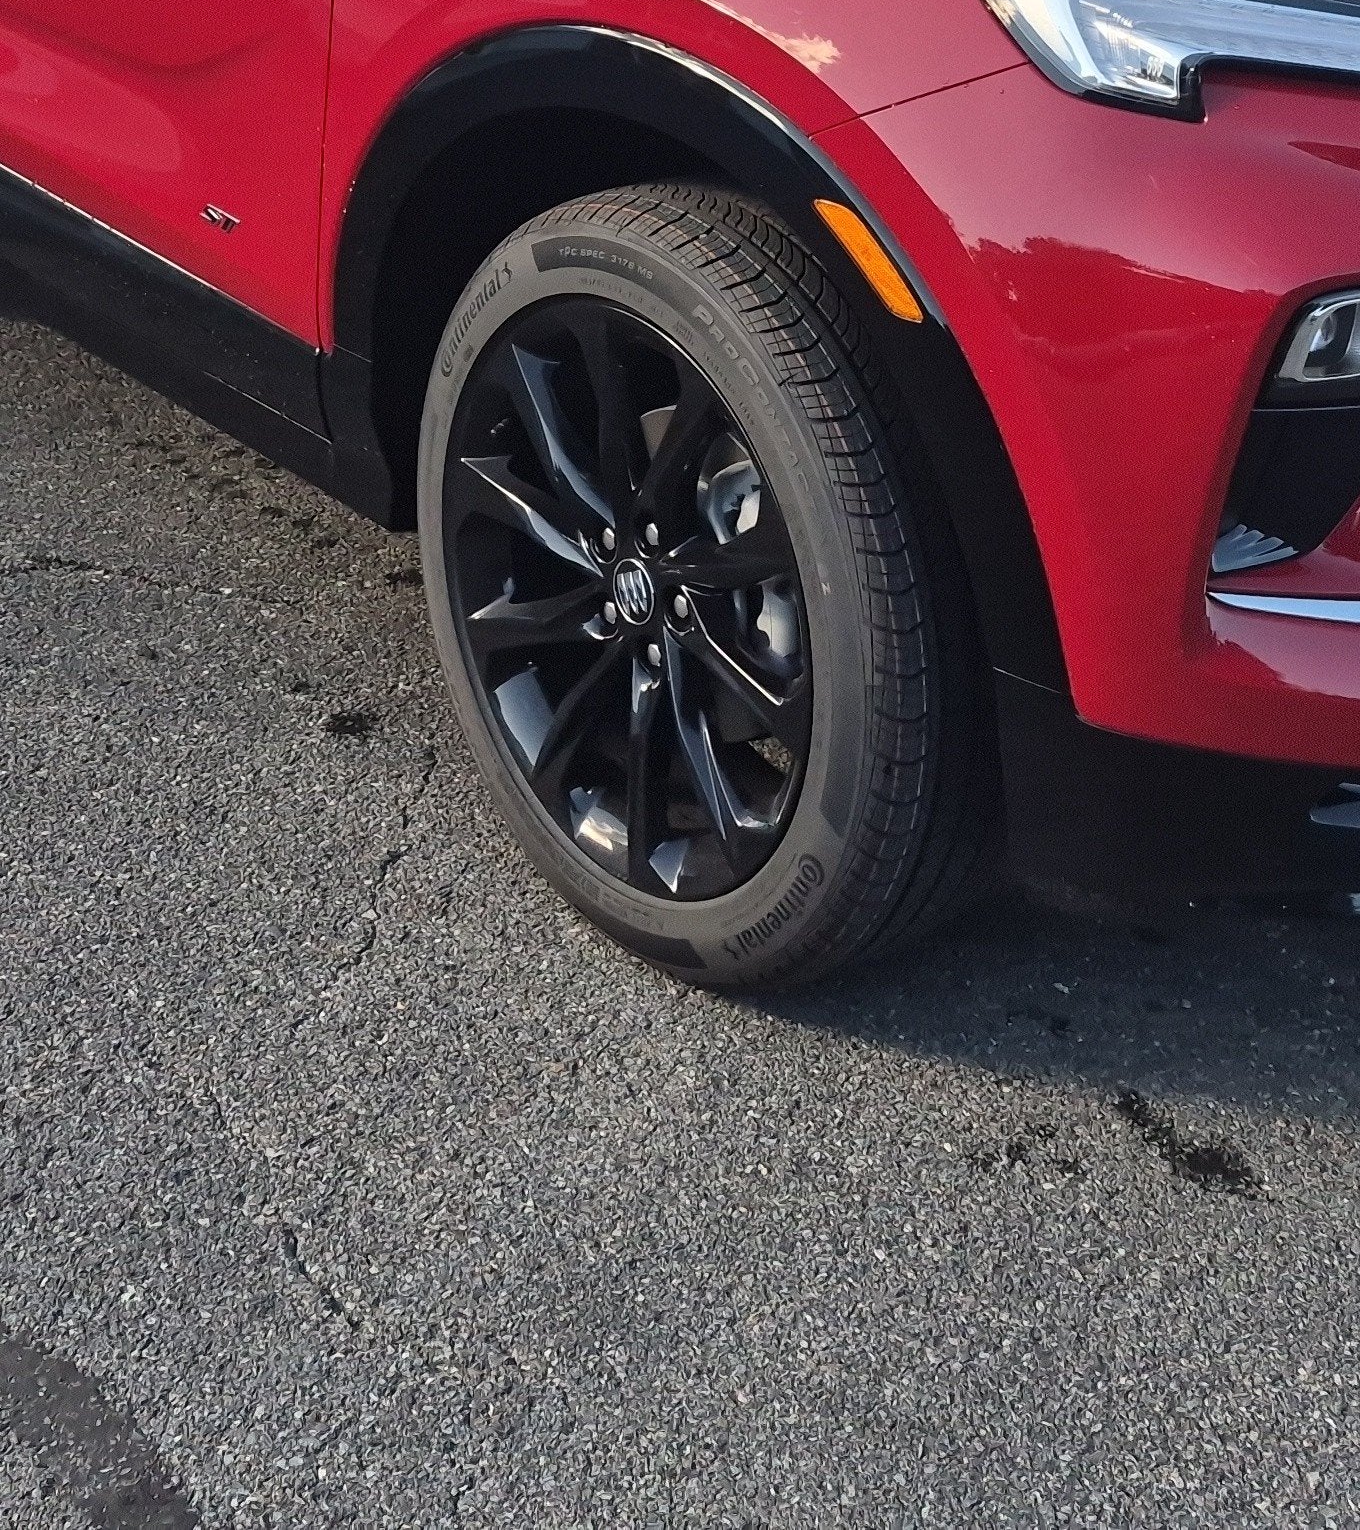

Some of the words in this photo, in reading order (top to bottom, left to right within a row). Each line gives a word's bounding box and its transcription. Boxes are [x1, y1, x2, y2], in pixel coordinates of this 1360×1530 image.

[199, 203, 241, 234] ST
[580, 248, 605, 259] SPEC
[441, 268, 503, 378] Continental
[735, 852, 825, 956] Continental
